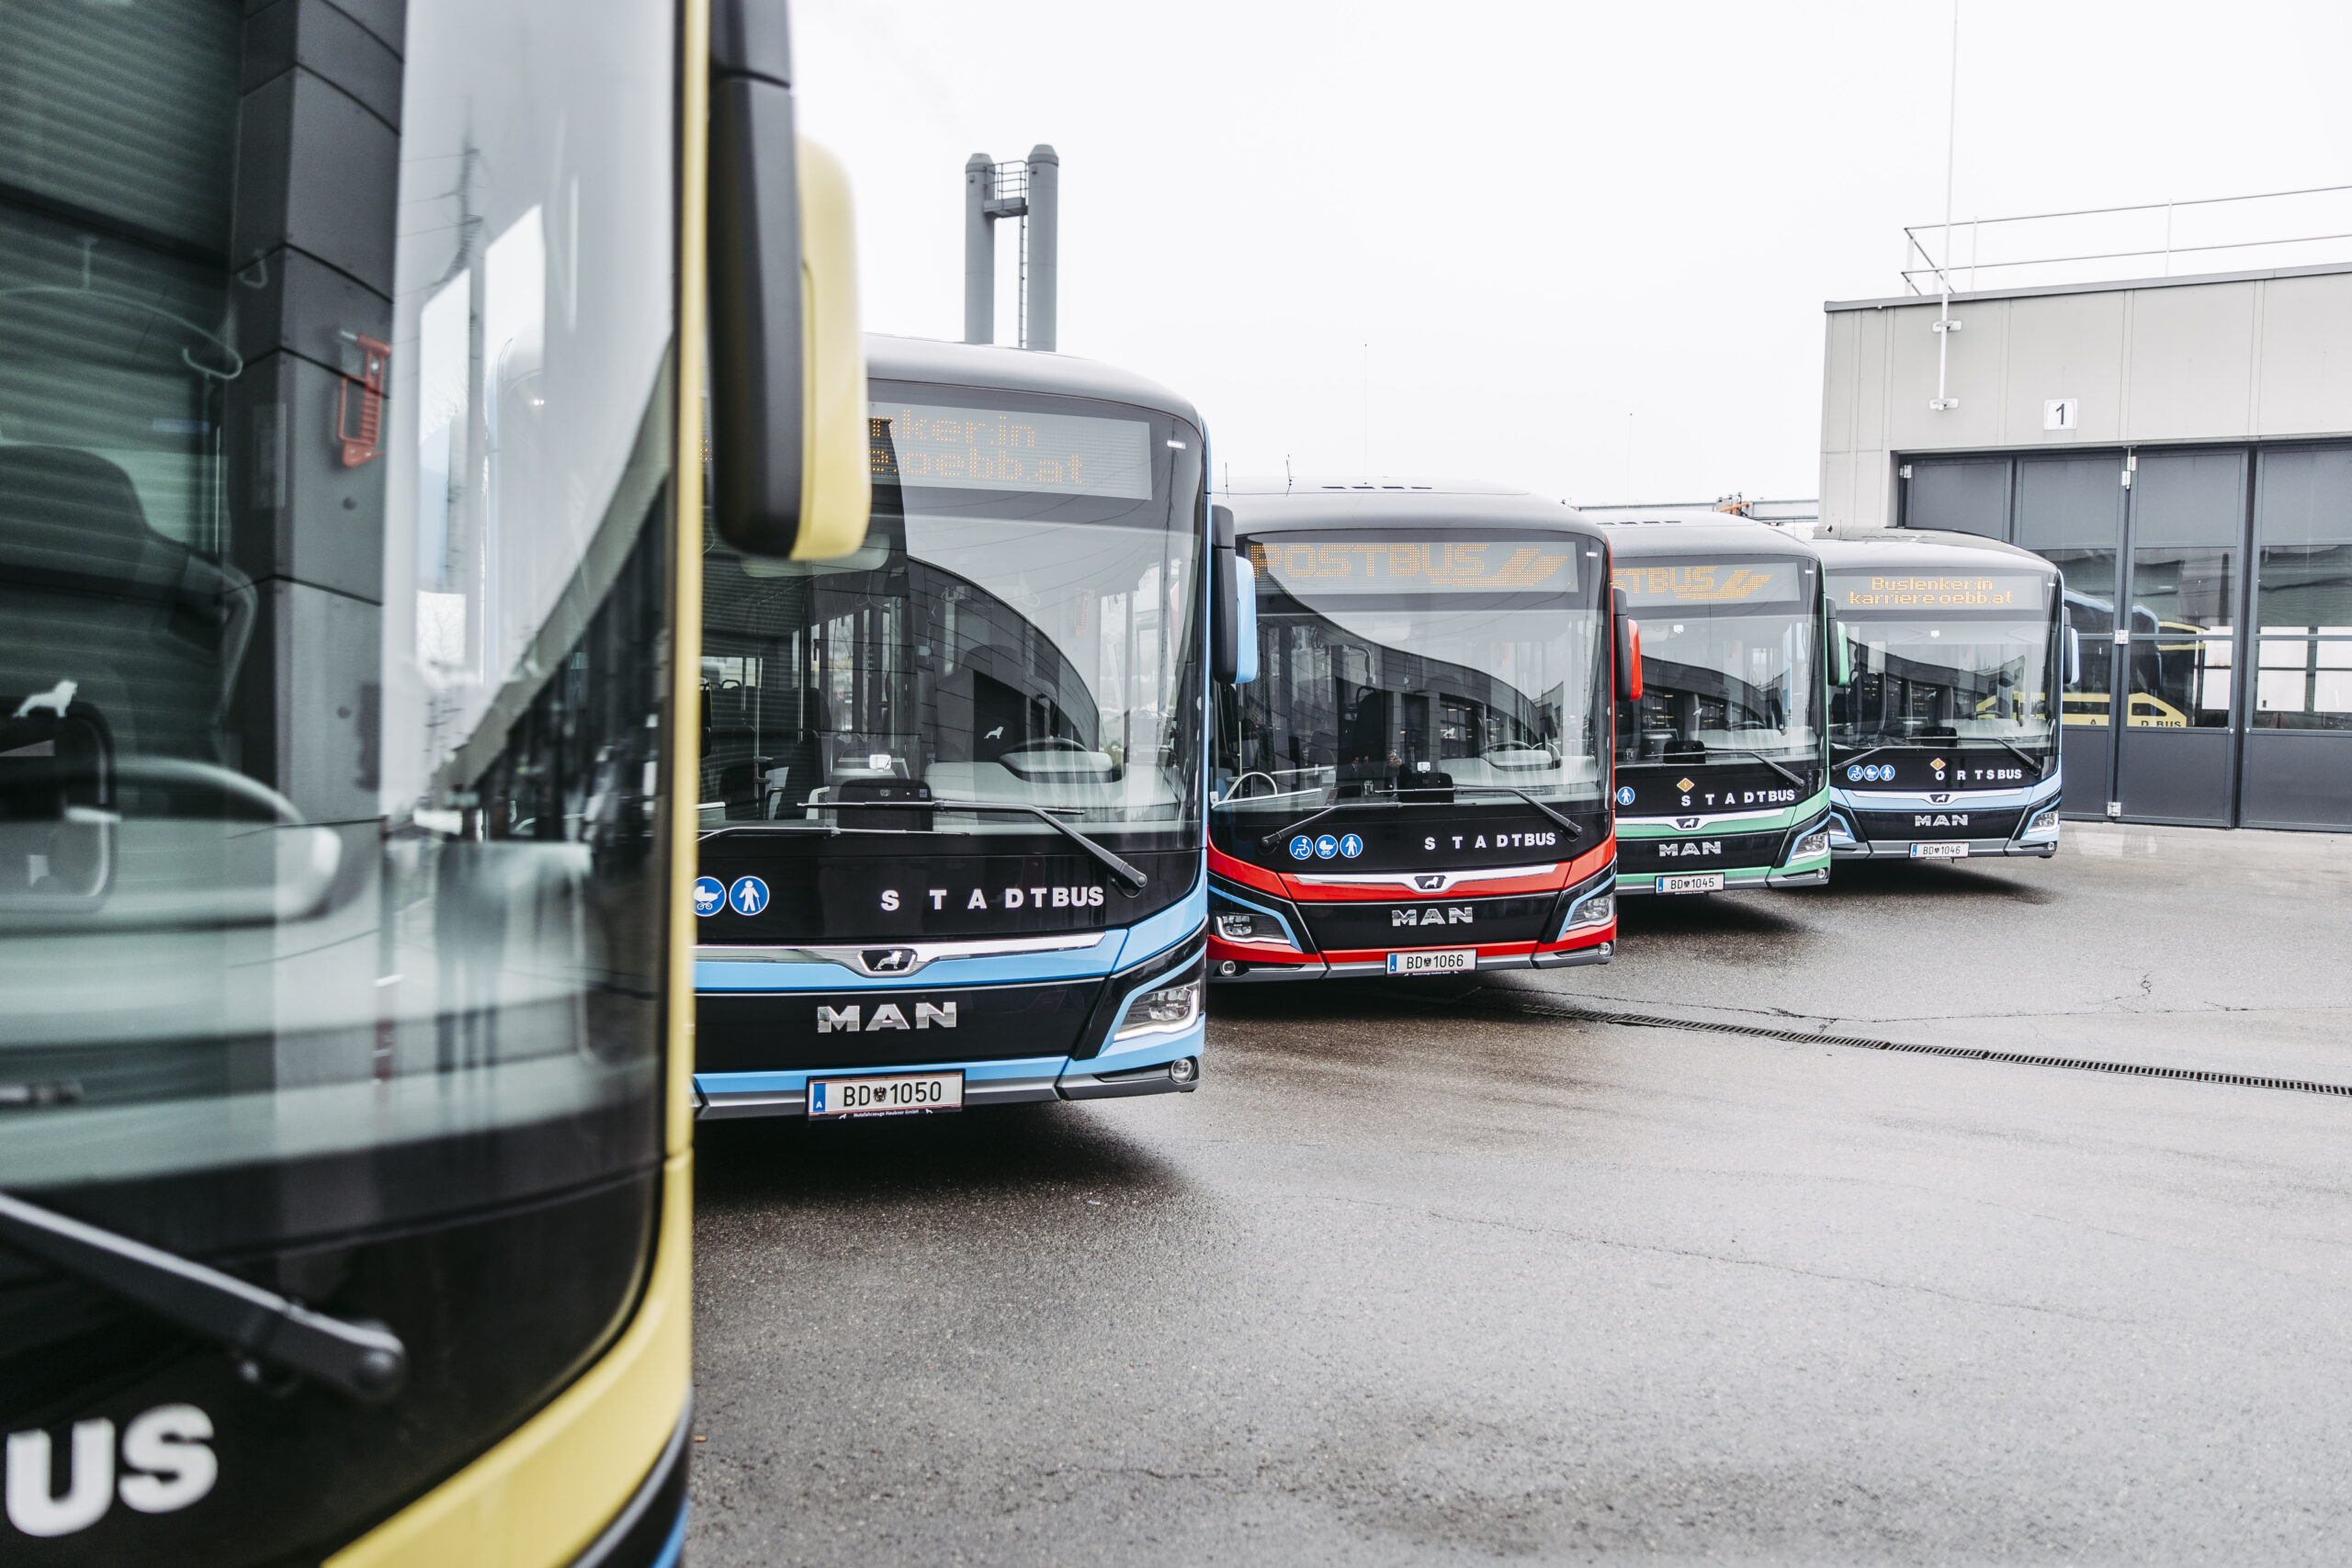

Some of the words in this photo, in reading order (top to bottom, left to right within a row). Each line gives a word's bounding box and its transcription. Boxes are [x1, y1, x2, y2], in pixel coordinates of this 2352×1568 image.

[2055, 402, 2065, 425] 1
[1250, 544, 1490, 579] POSTBUS
[1680, 789, 1795, 807] STADTBUS
[1914, 814, 1969, 827] MAN
[1424, 832, 1556, 851] STADTBUS
[1658, 840, 1722, 857] MAN
[1940, 845, 1962, 854] 1046
[1670, 879, 1683, 890] BD
[1690, 877, 1715, 888] 1045
[880, 886, 1104, 912] STADTBUS
[1391, 907, 1474, 927] MAN
[1406, 956, 1423, 969] BD
[1433, 953, 1464, 968] 1066
[817, 1001, 957, 1033] MAN
[843, 1086, 871, 1107] BD
[889, 1080, 943, 1105] 1050
[5, 1402, 219, 1539] US
